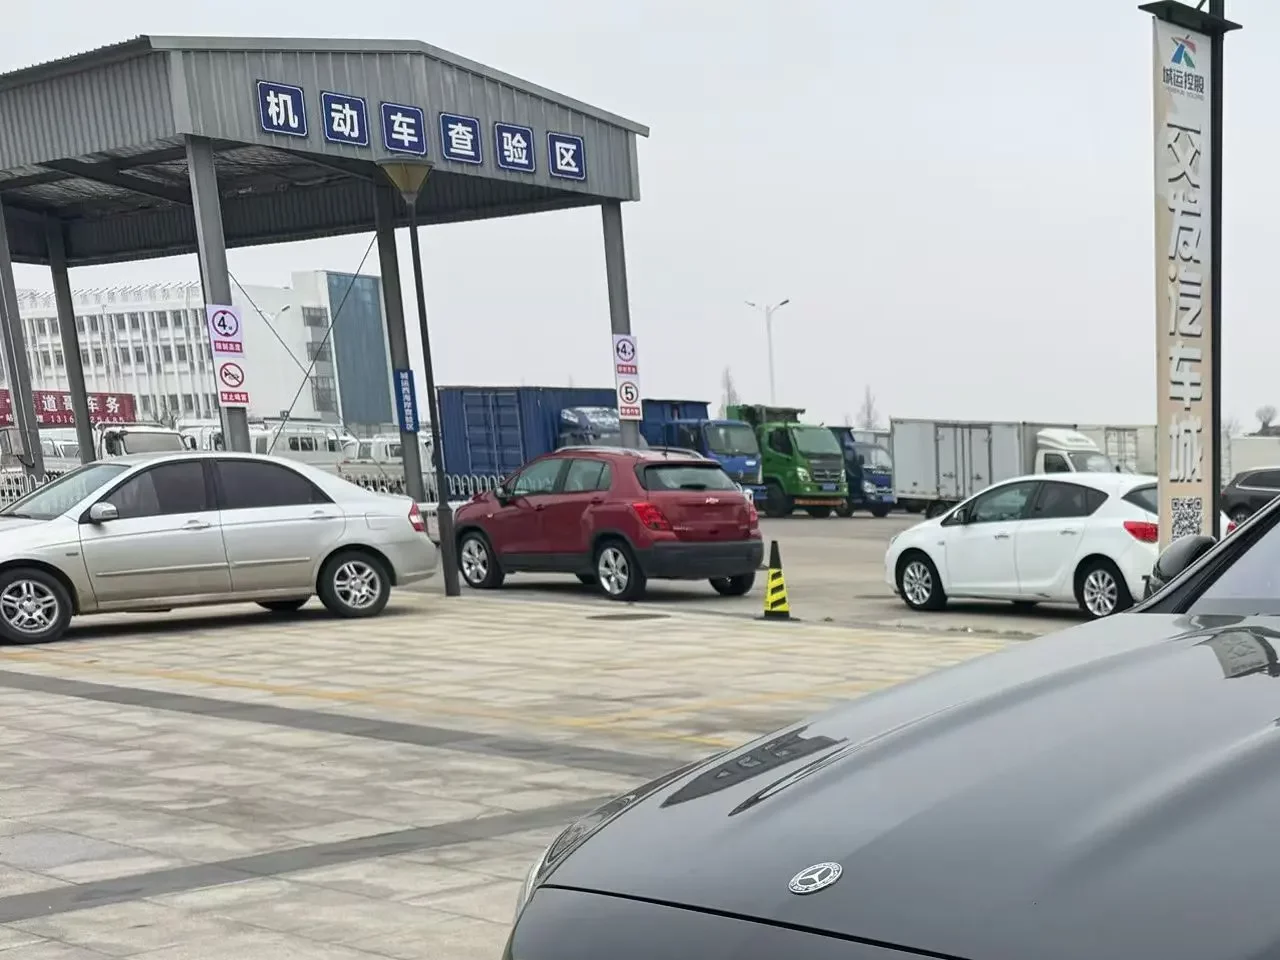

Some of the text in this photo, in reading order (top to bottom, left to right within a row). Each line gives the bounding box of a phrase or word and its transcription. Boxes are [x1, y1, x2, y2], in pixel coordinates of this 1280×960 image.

[1163, 66, 1204, 93] 城运控股
[266, 90, 579, 172] 机动车查验区
[624, 386, 635, 401] 5
